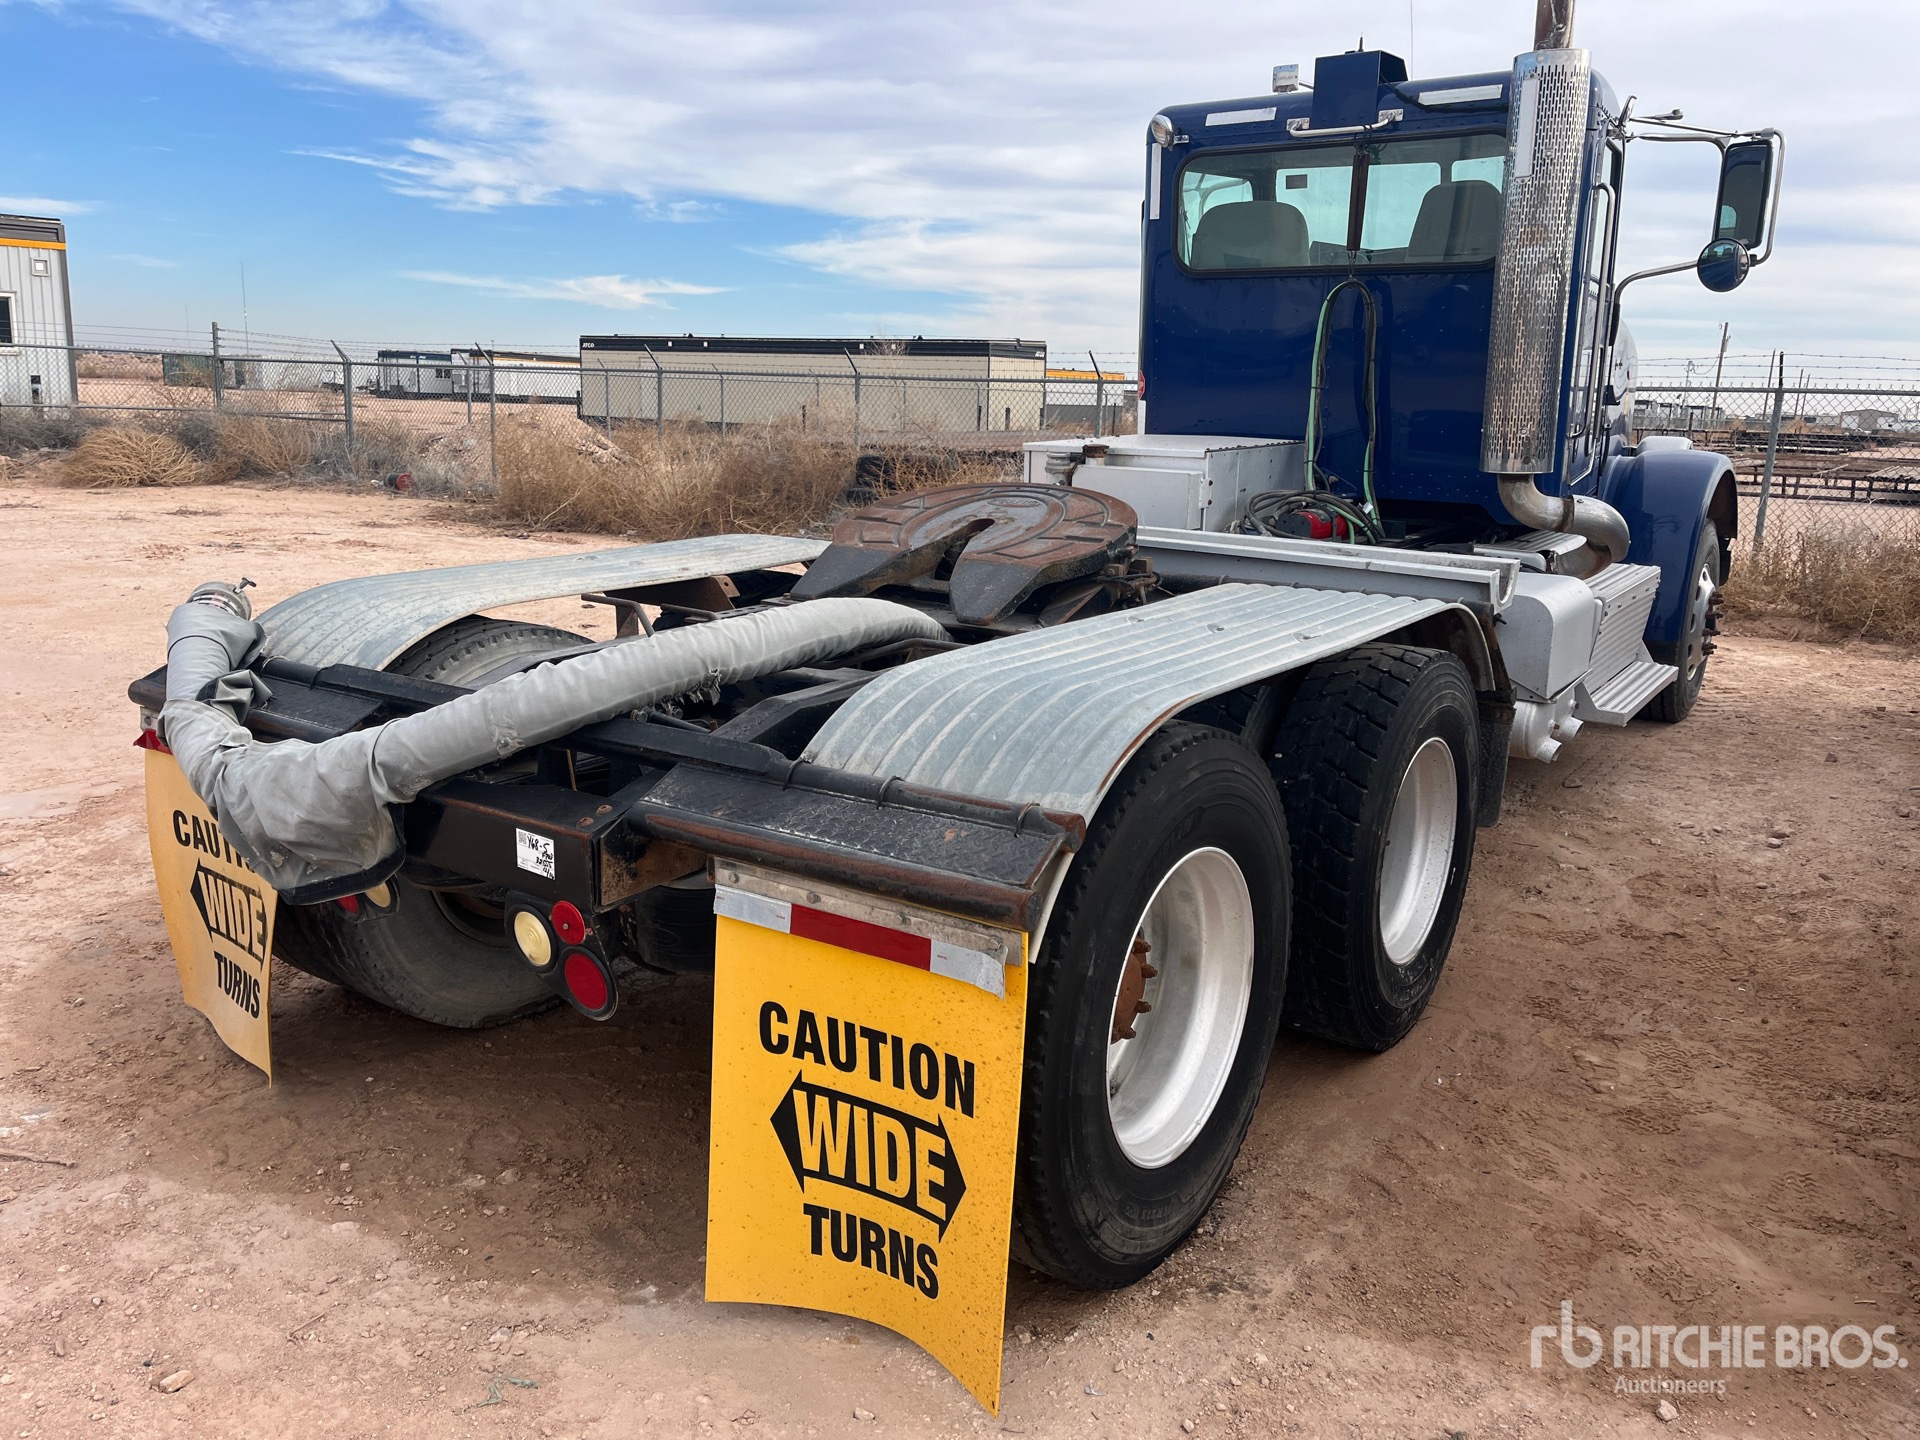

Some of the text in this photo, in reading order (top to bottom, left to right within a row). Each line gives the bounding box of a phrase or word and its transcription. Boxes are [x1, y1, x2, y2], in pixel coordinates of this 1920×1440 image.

[197, 870, 265, 960] WIDE
[213, 950, 261, 1020] TURNS
[758, 1000, 976, 1119] CAUTION
[792, 1088, 947, 1222] WIDE
[803, 1202, 940, 1300] TURNS
